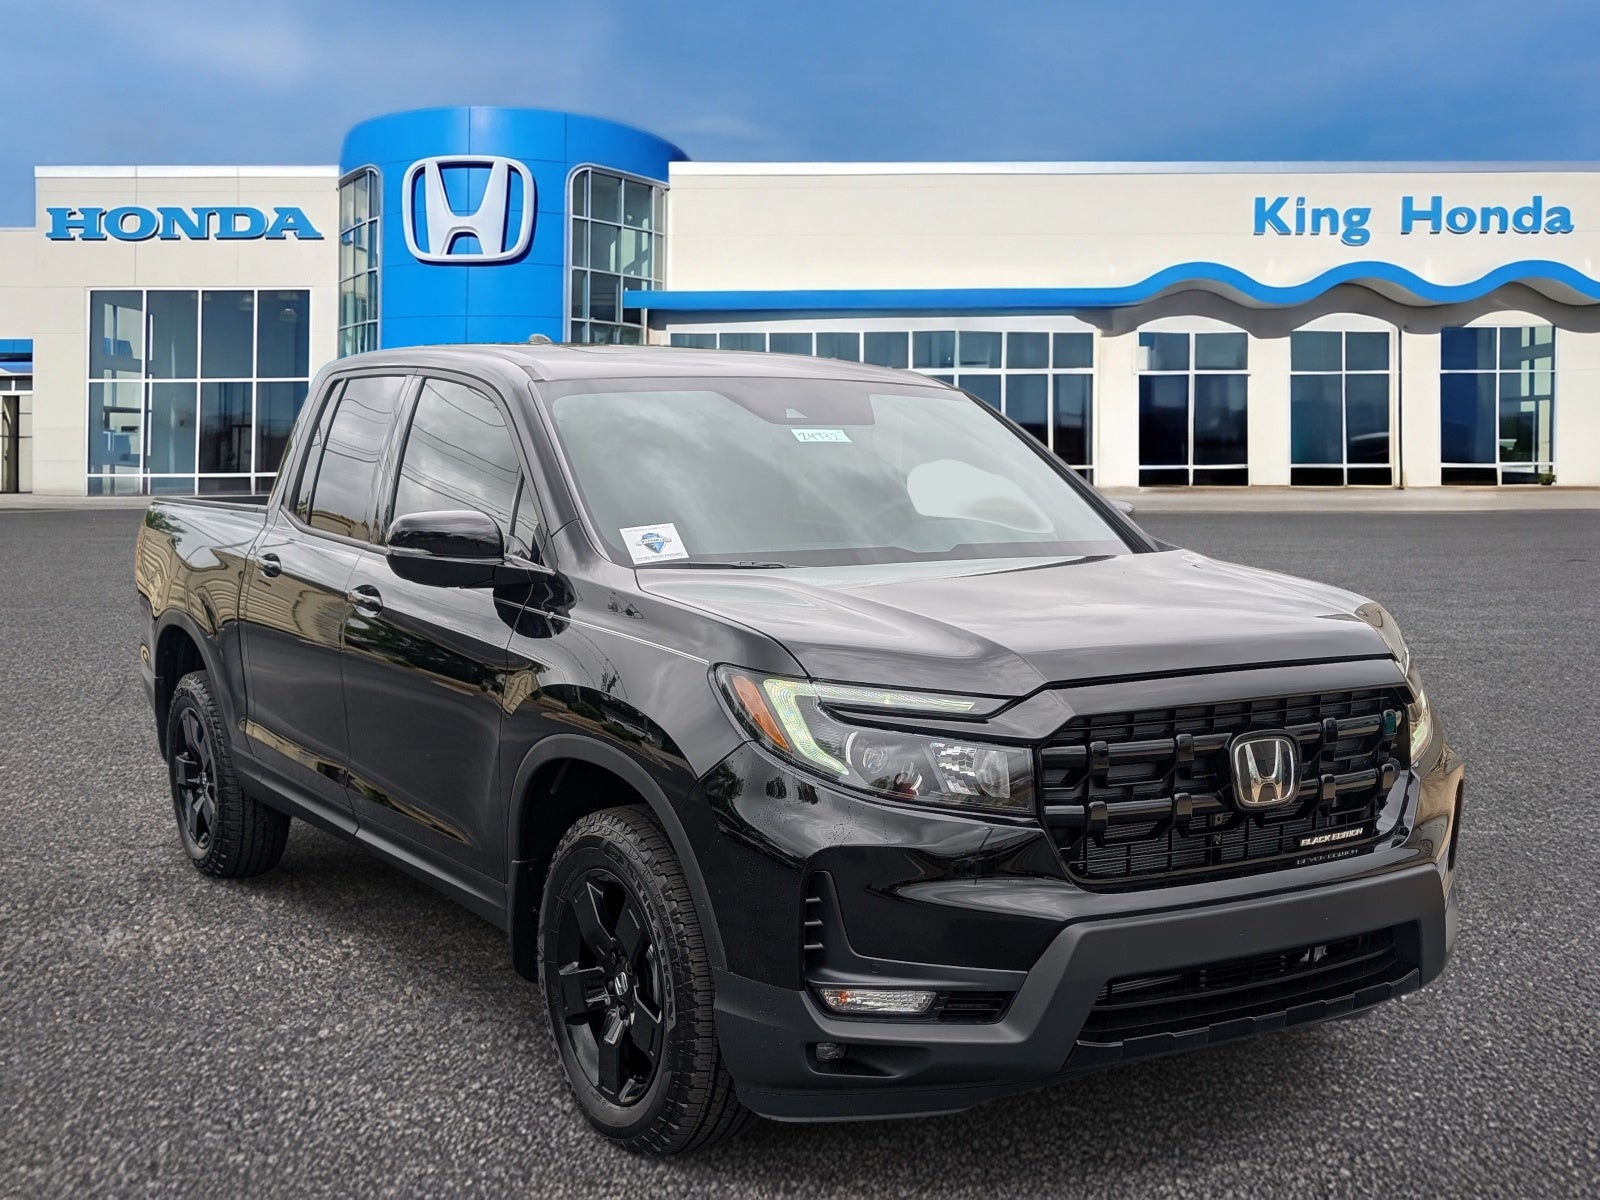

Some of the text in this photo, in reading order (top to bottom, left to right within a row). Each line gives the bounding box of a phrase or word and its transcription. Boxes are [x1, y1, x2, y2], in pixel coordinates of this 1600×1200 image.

[45, 206, 325, 241] HONDA
[1253, 195, 1575, 247] King Honda
[1300, 828, 1363, 846] BLACK EDITION
